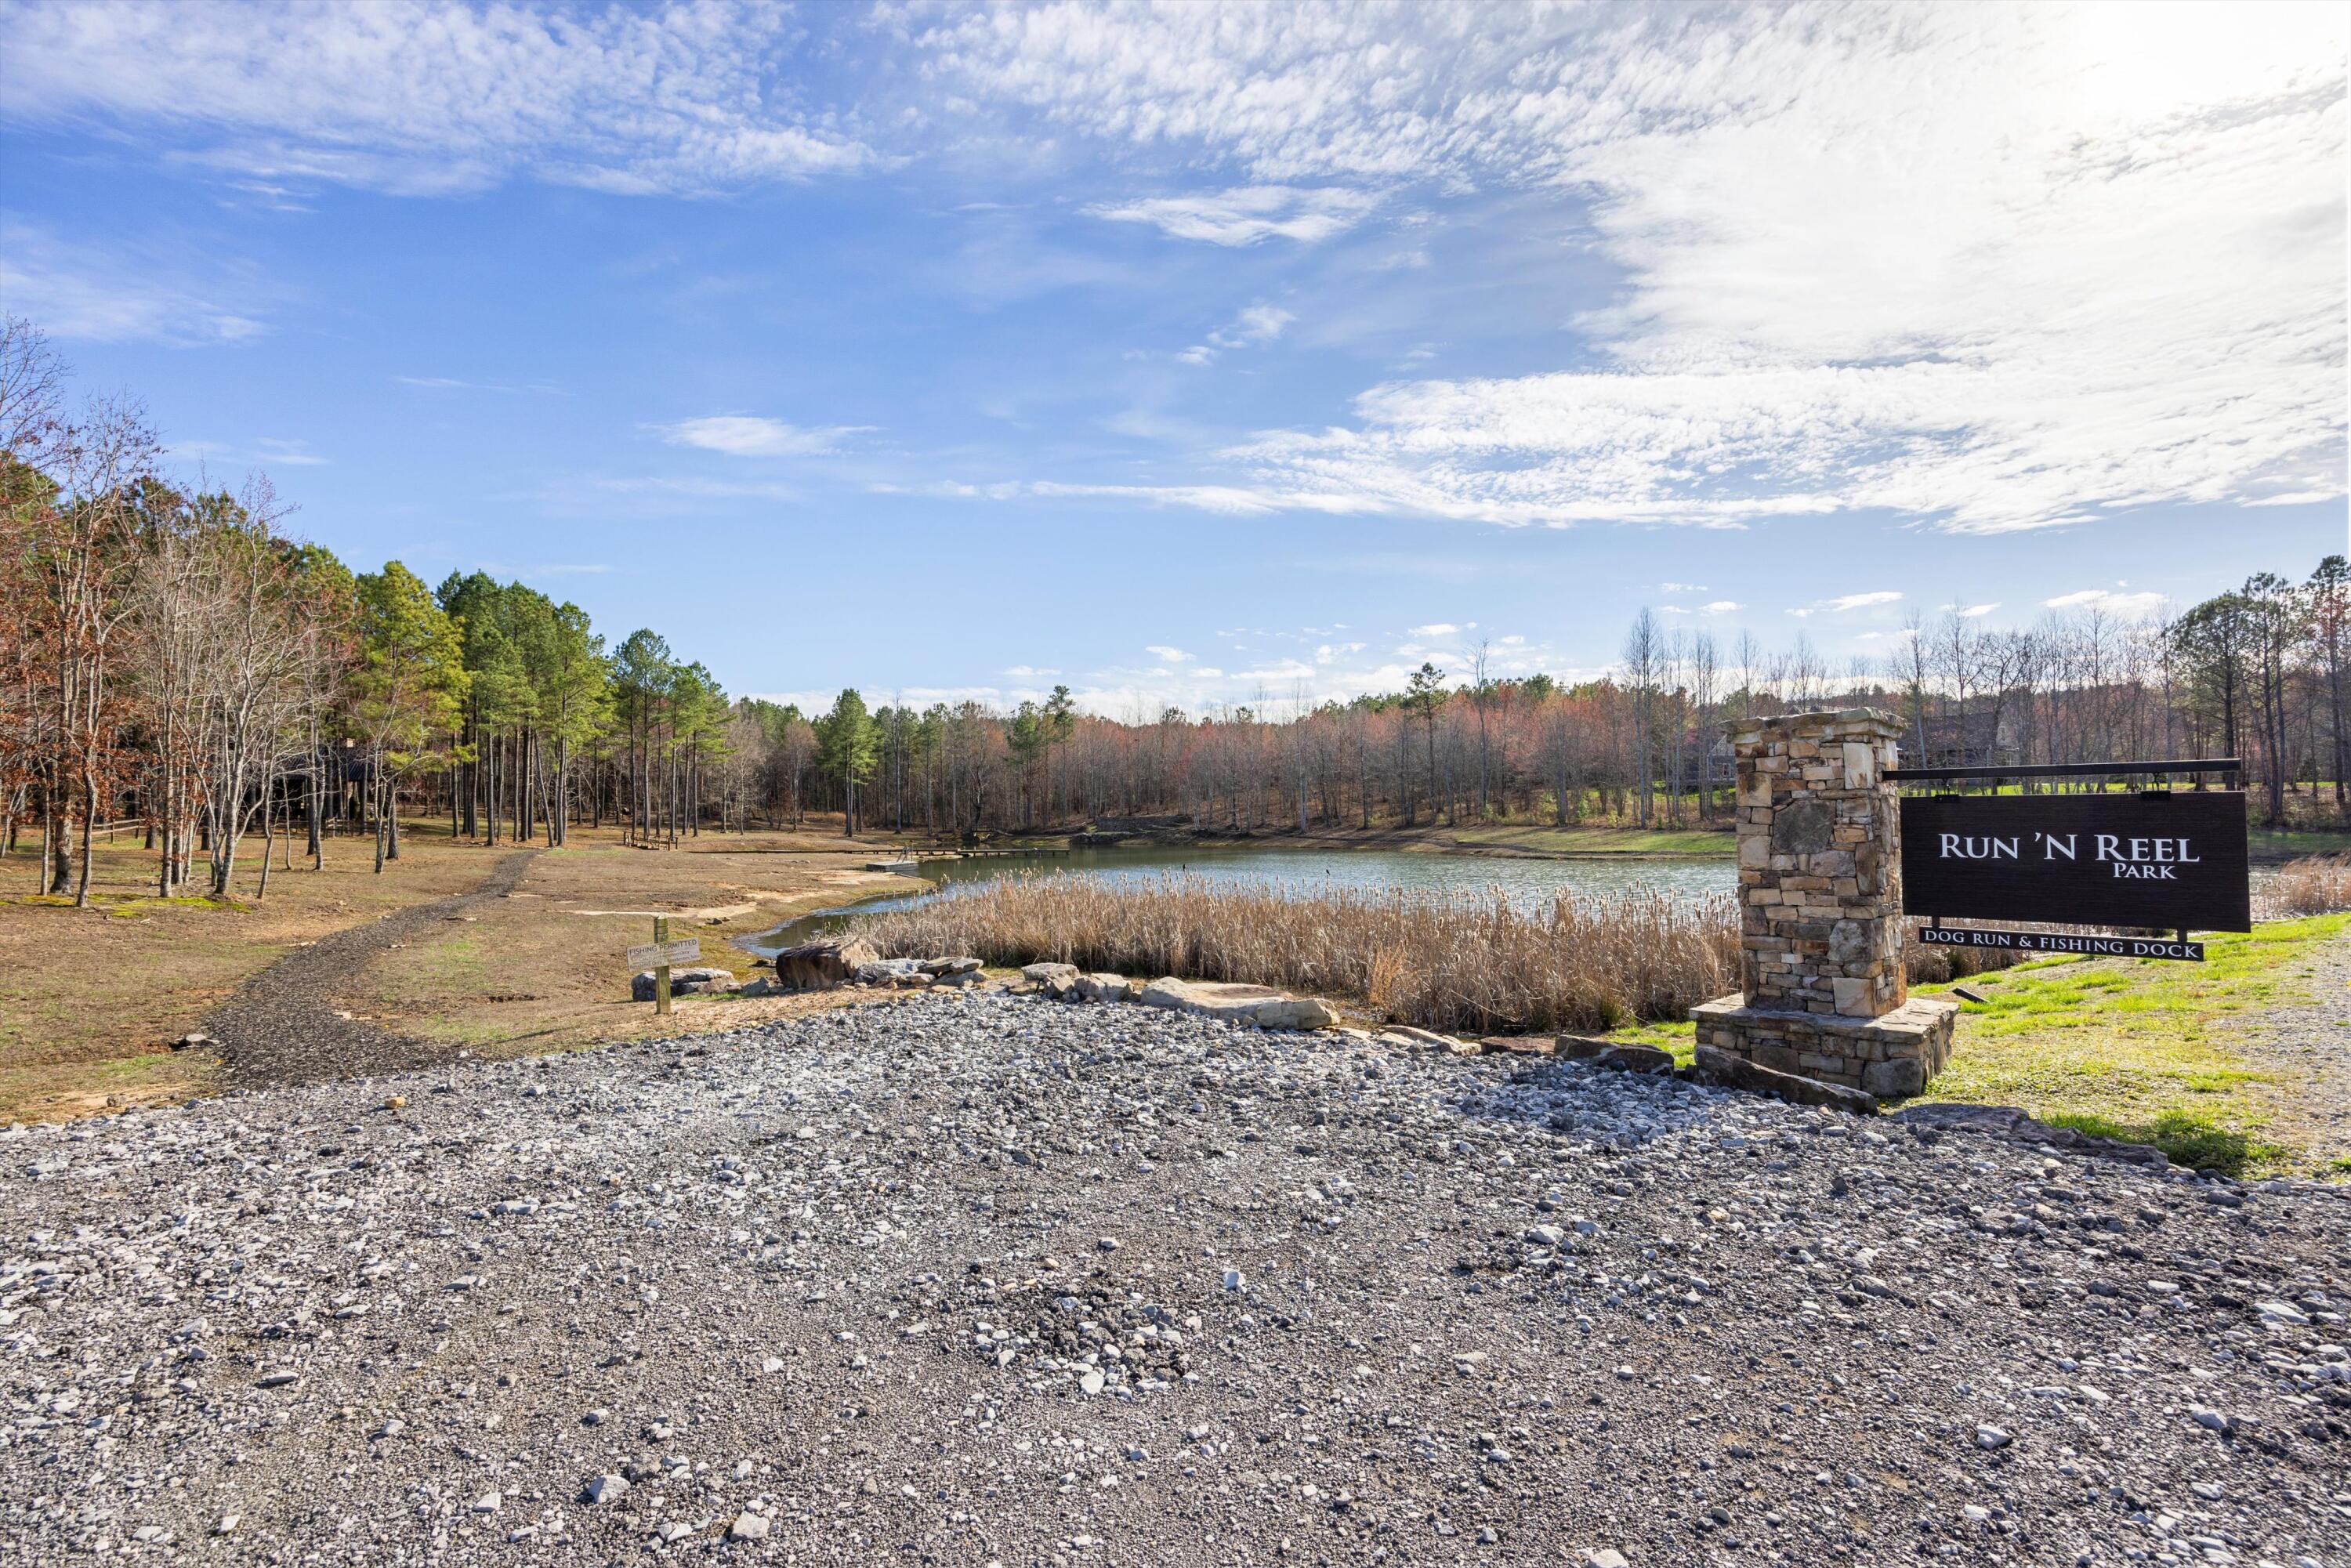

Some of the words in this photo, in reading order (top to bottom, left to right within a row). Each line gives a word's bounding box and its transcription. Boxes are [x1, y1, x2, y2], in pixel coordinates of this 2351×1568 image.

[1938, 833, 2020, 860] RUN
[2034, 831, 2078, 861] 'N
[2093, 834, 2200, 863] REEL
[2114, 863, 2178, 879] PARK
[629, 945, 657, 956] FISHING
[659, 939, 697, 951] PERMITTED
[1925, 930, 1965, 943] DOG
[1972, 932, 2012, 946] RUN
[2019, 936, 2034, 947] &
[2040, 938, 2124, 954] FISHING
[2134, 943, 2199, 958] DOCK
